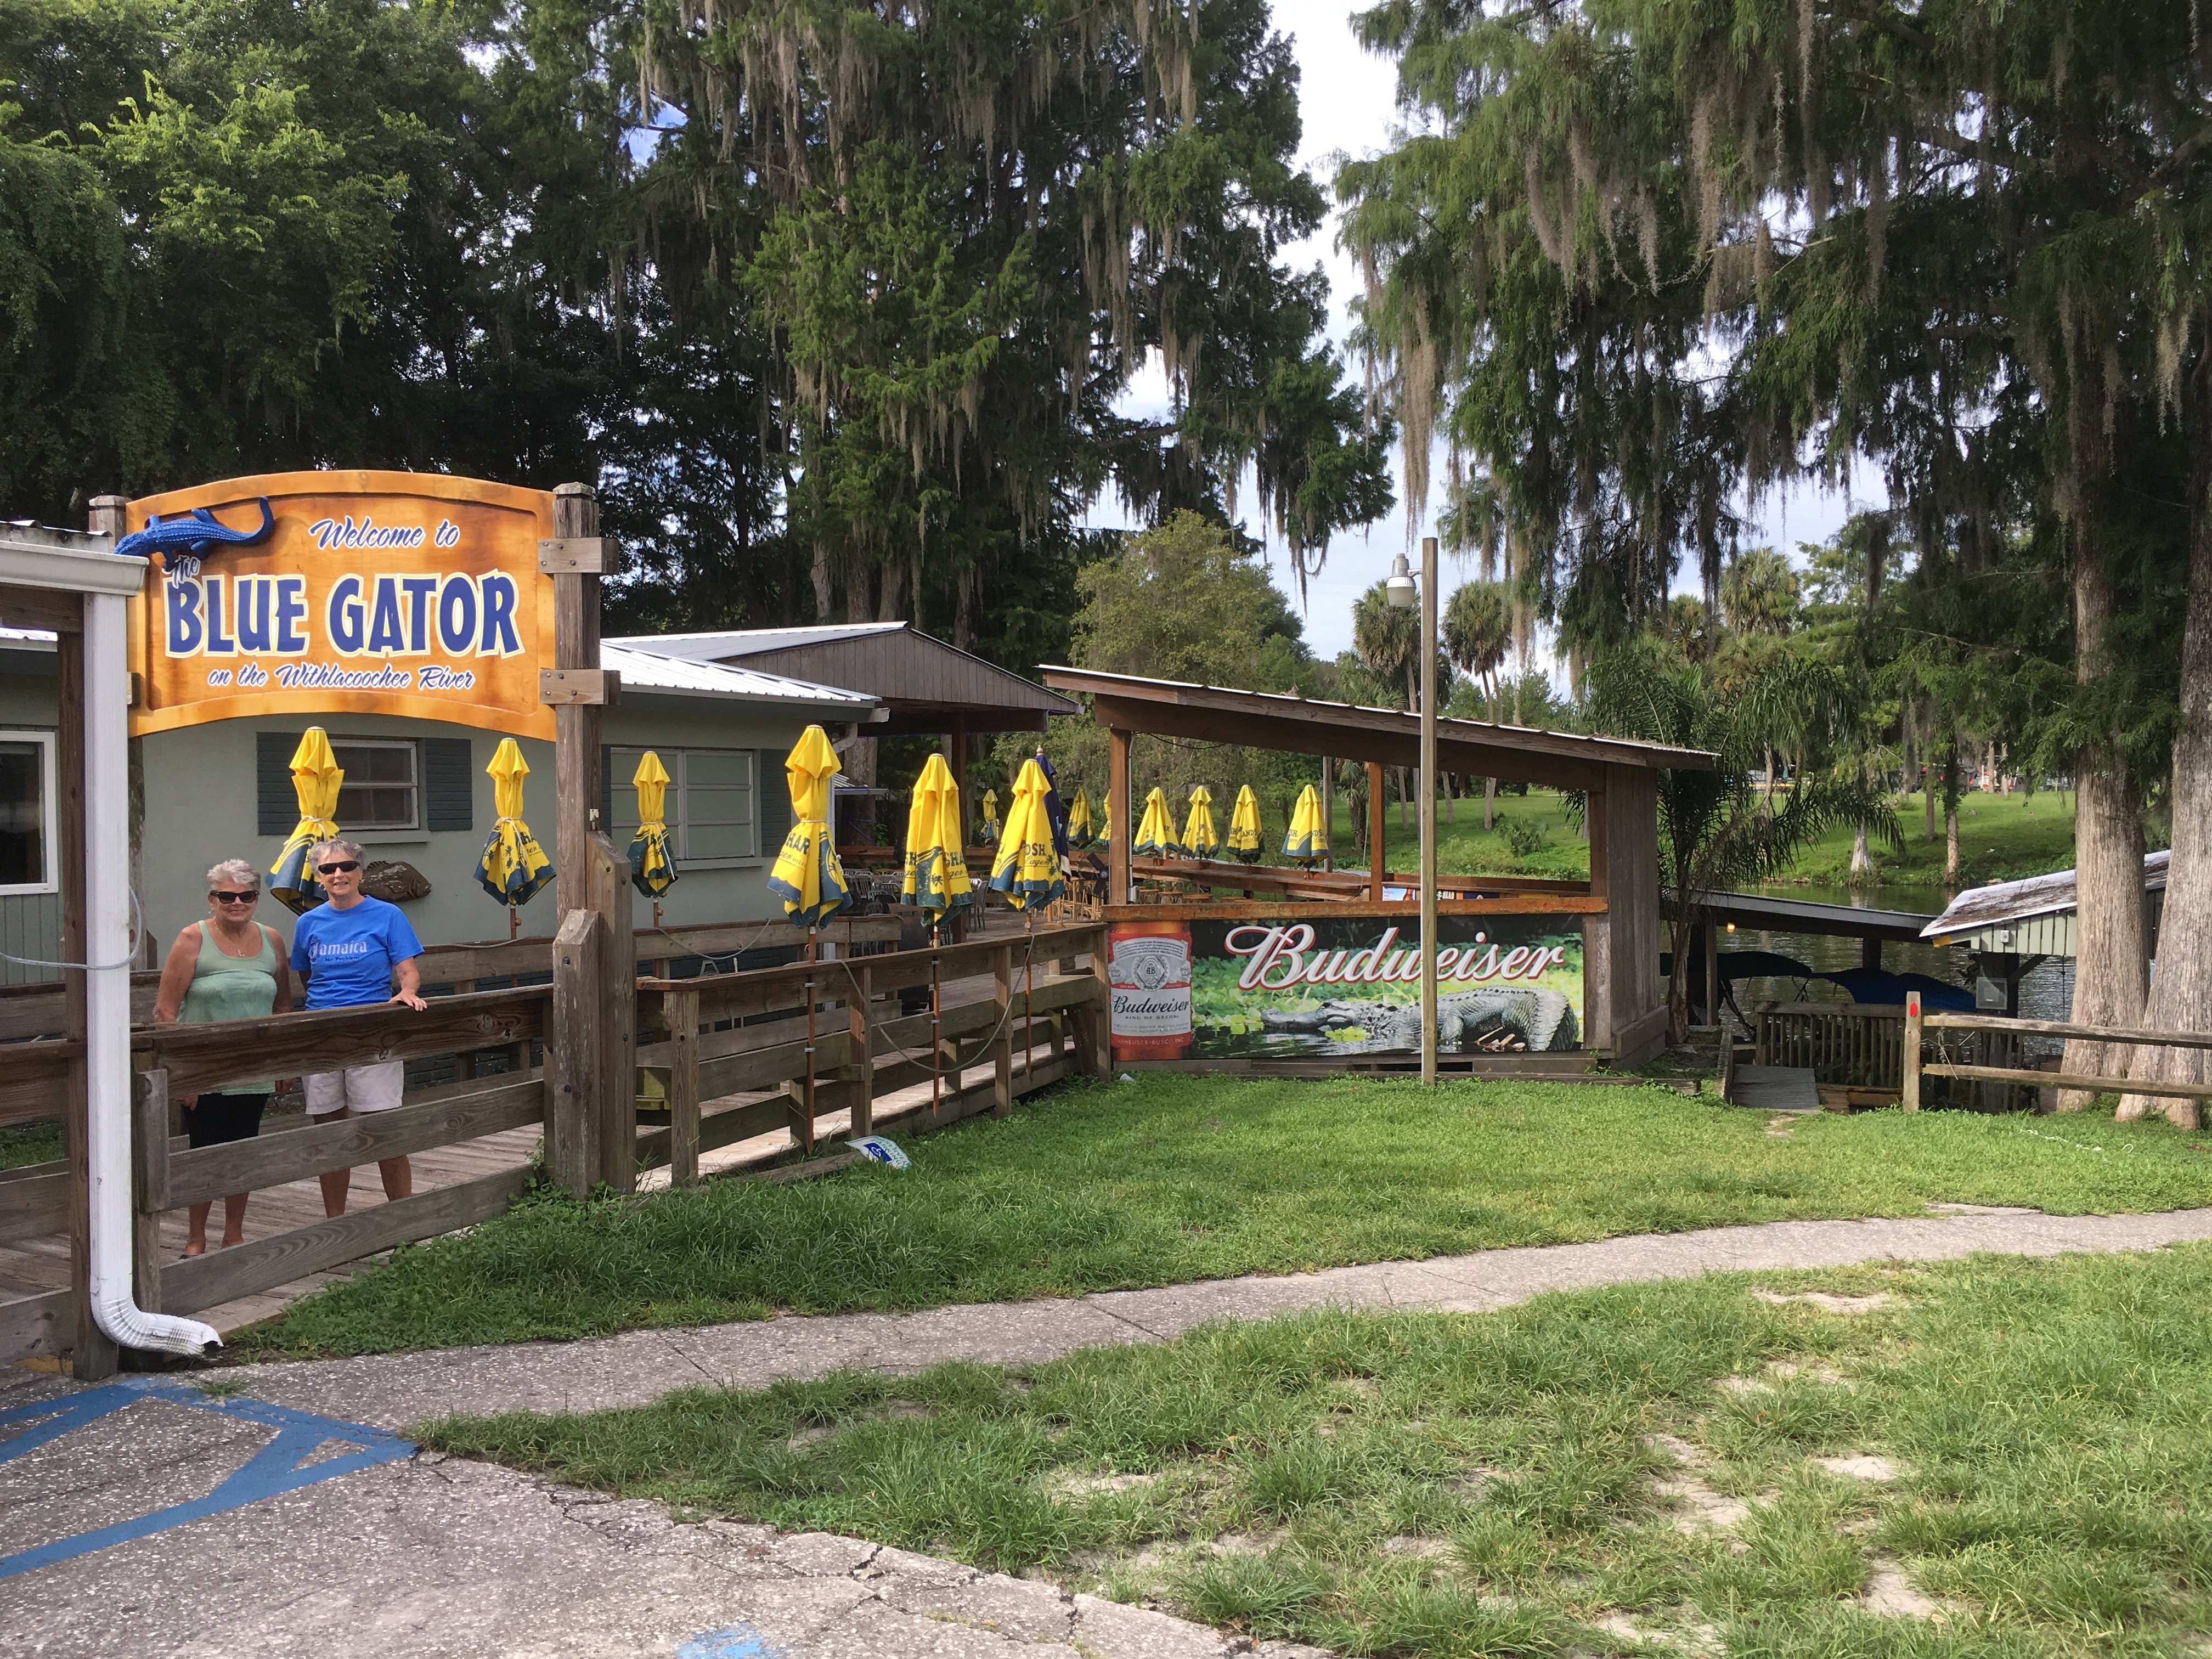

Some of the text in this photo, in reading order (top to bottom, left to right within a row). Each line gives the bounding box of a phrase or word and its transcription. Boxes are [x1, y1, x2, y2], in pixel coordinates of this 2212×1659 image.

[308, 515, 460, 550] Welcome to
[163, 568, 526, 659] BLUE GATOR
[208, 661, 476, 690] on the Withlacoochee River
[309, 940, 368, 959] Jamaica
[1224, 923, 1565, 991] Budweiser
[1111, 995, 1189, 1014] Budweiser
